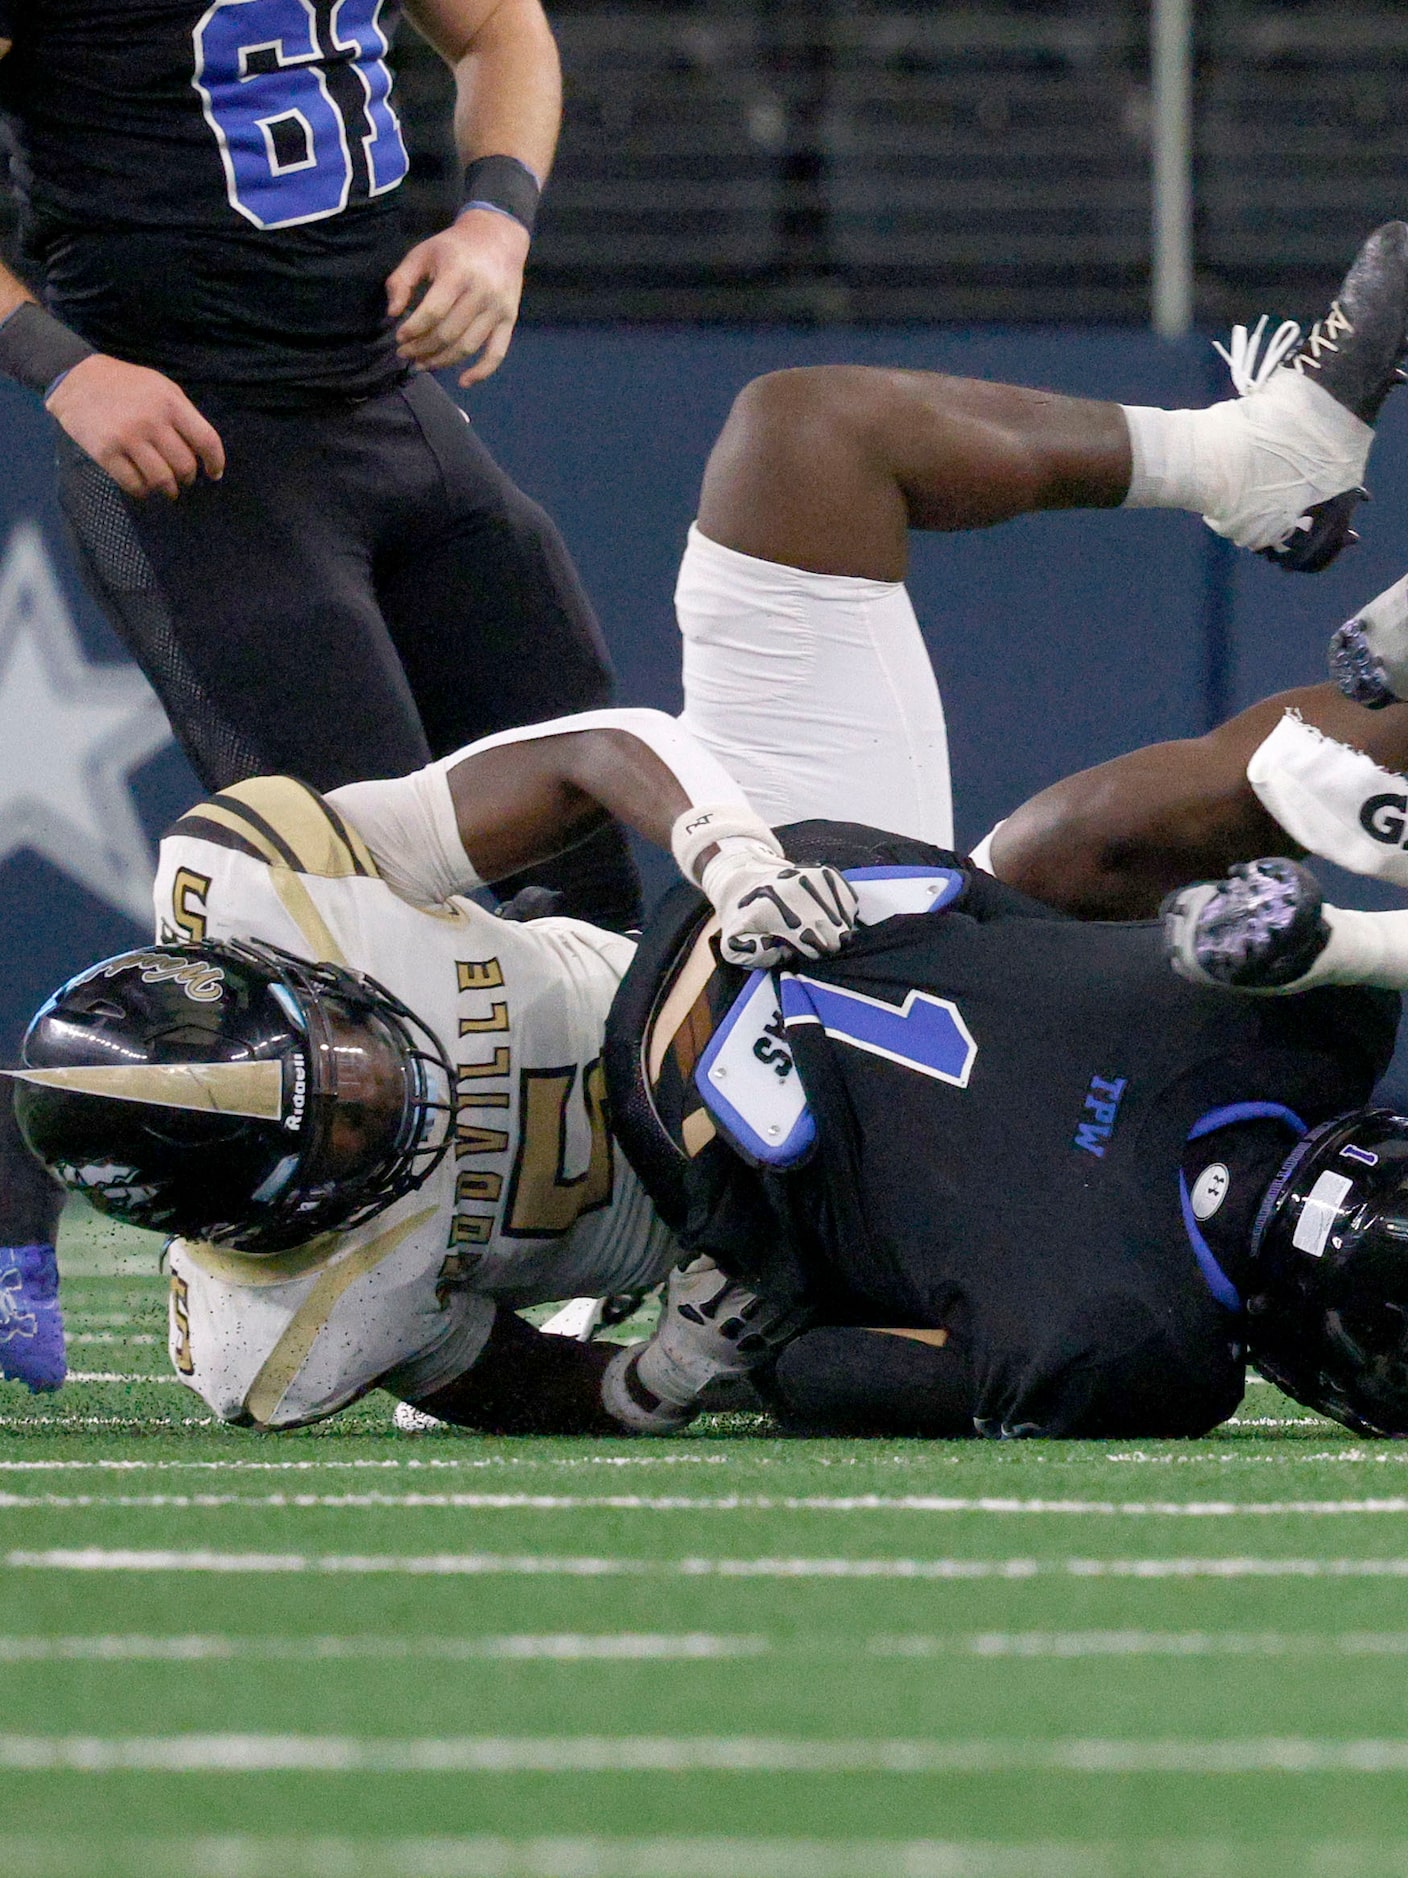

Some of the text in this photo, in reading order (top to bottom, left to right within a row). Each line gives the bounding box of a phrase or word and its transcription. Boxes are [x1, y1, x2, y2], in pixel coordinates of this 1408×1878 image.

[191, 0, 410, 231] 61
[780, 970, 978, 1089] 1
[284, 1053, 306, 1131] Riddell
[1074, 1075, 1128, 1158] TPW
